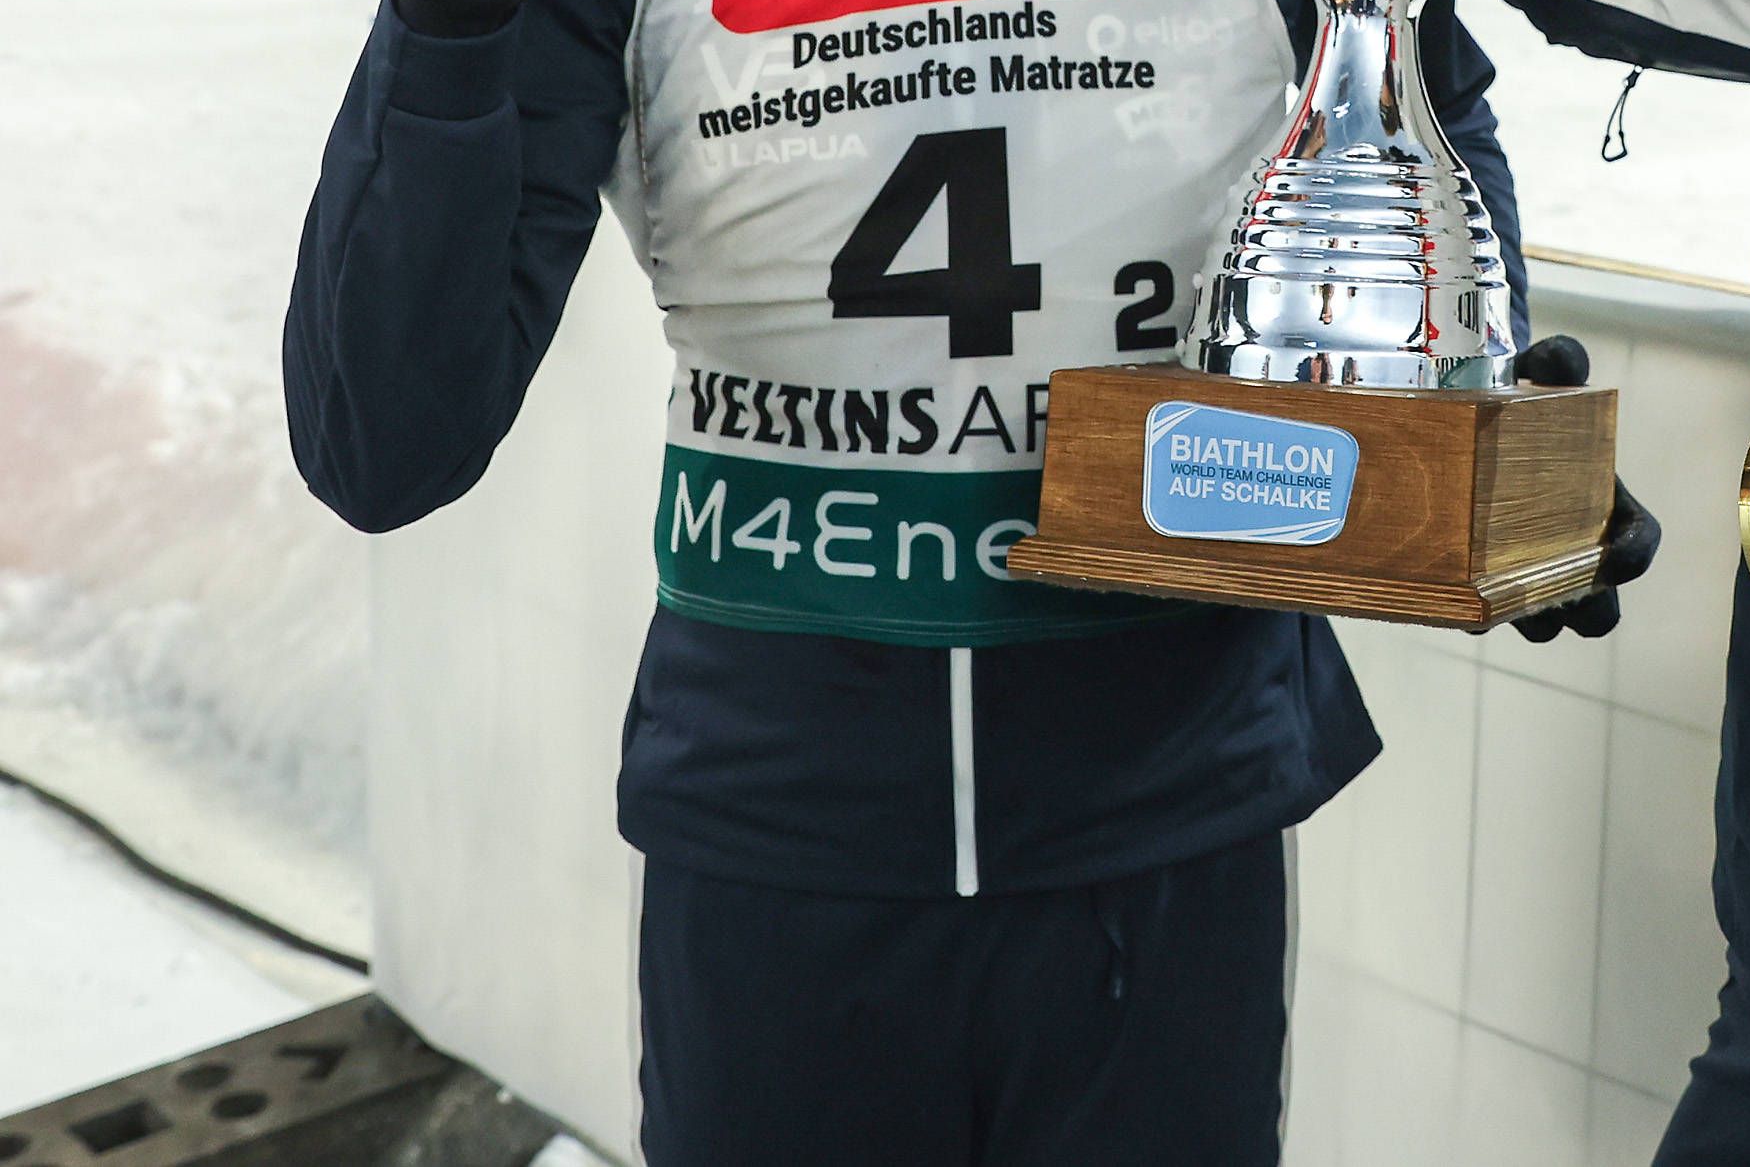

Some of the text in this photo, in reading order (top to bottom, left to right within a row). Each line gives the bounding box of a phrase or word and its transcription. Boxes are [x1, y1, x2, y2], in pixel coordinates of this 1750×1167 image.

[793, 1, 1057, 69] Deutschlands
[699, 58, 977, 139] meistgekaufte
[990, 54, 1156, 94] Matratze
[828, 126, 1042, 359] 4
[1113, 260, 1178, 352] 2
[1170, 434, 1334, 476] BIATHLON
[1170, 463, 1332, 490] WORLD TEAM CHALLENGE
[1169, 476, 1332, 511] AUF SCHALKE
